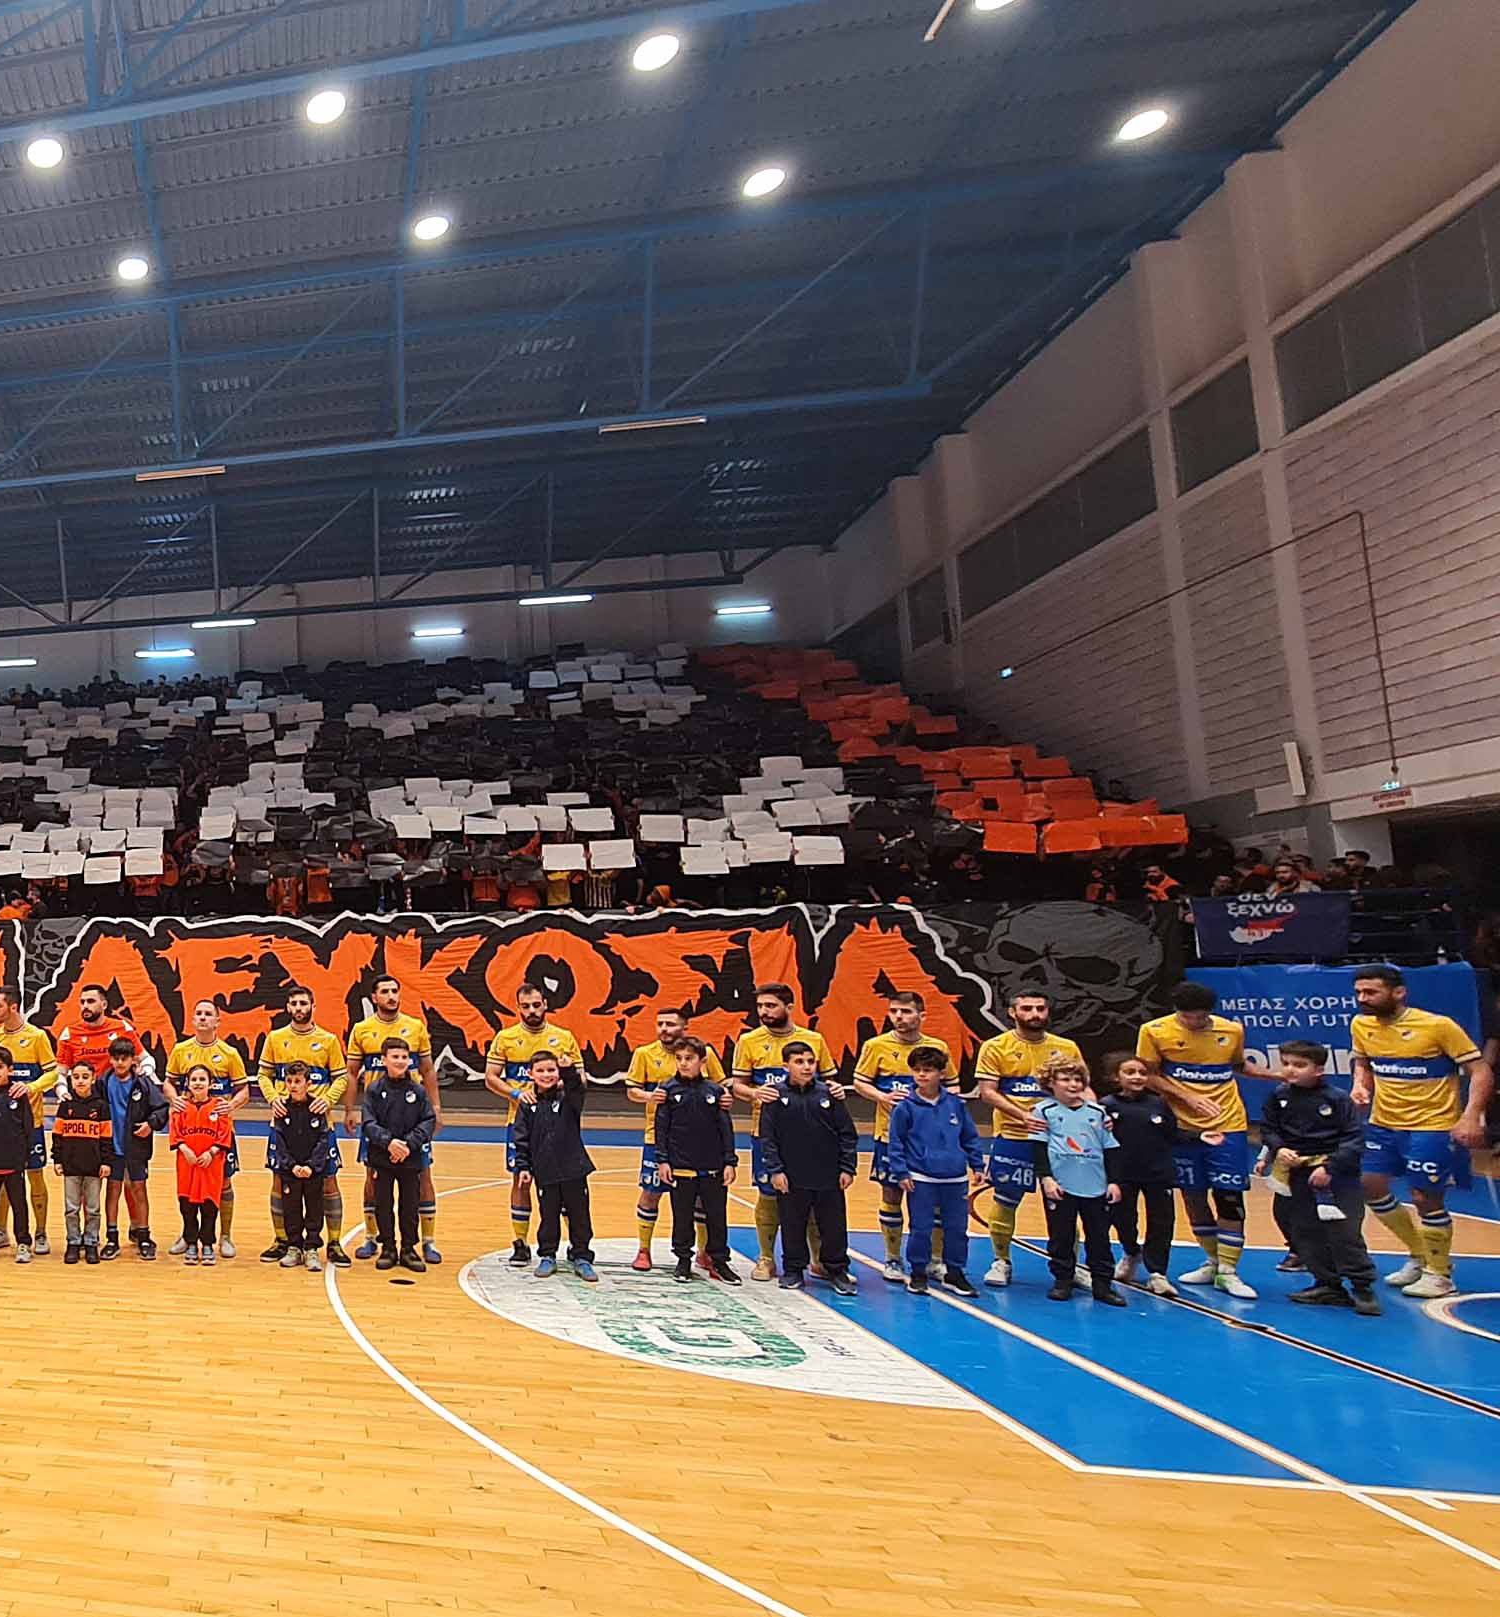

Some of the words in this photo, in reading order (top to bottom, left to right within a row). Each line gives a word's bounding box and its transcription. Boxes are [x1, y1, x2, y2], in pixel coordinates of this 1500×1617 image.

[1226, 899, 1295, 918] ξεχνώ
[45, 917, 983, 1068] ΛΕΥΚΩΣΙΑ
[1222, 999, 1286, 1011] ΜΕΓΑΣ
[1295, 996, 1357, 1009] ΧΟΡΗ
